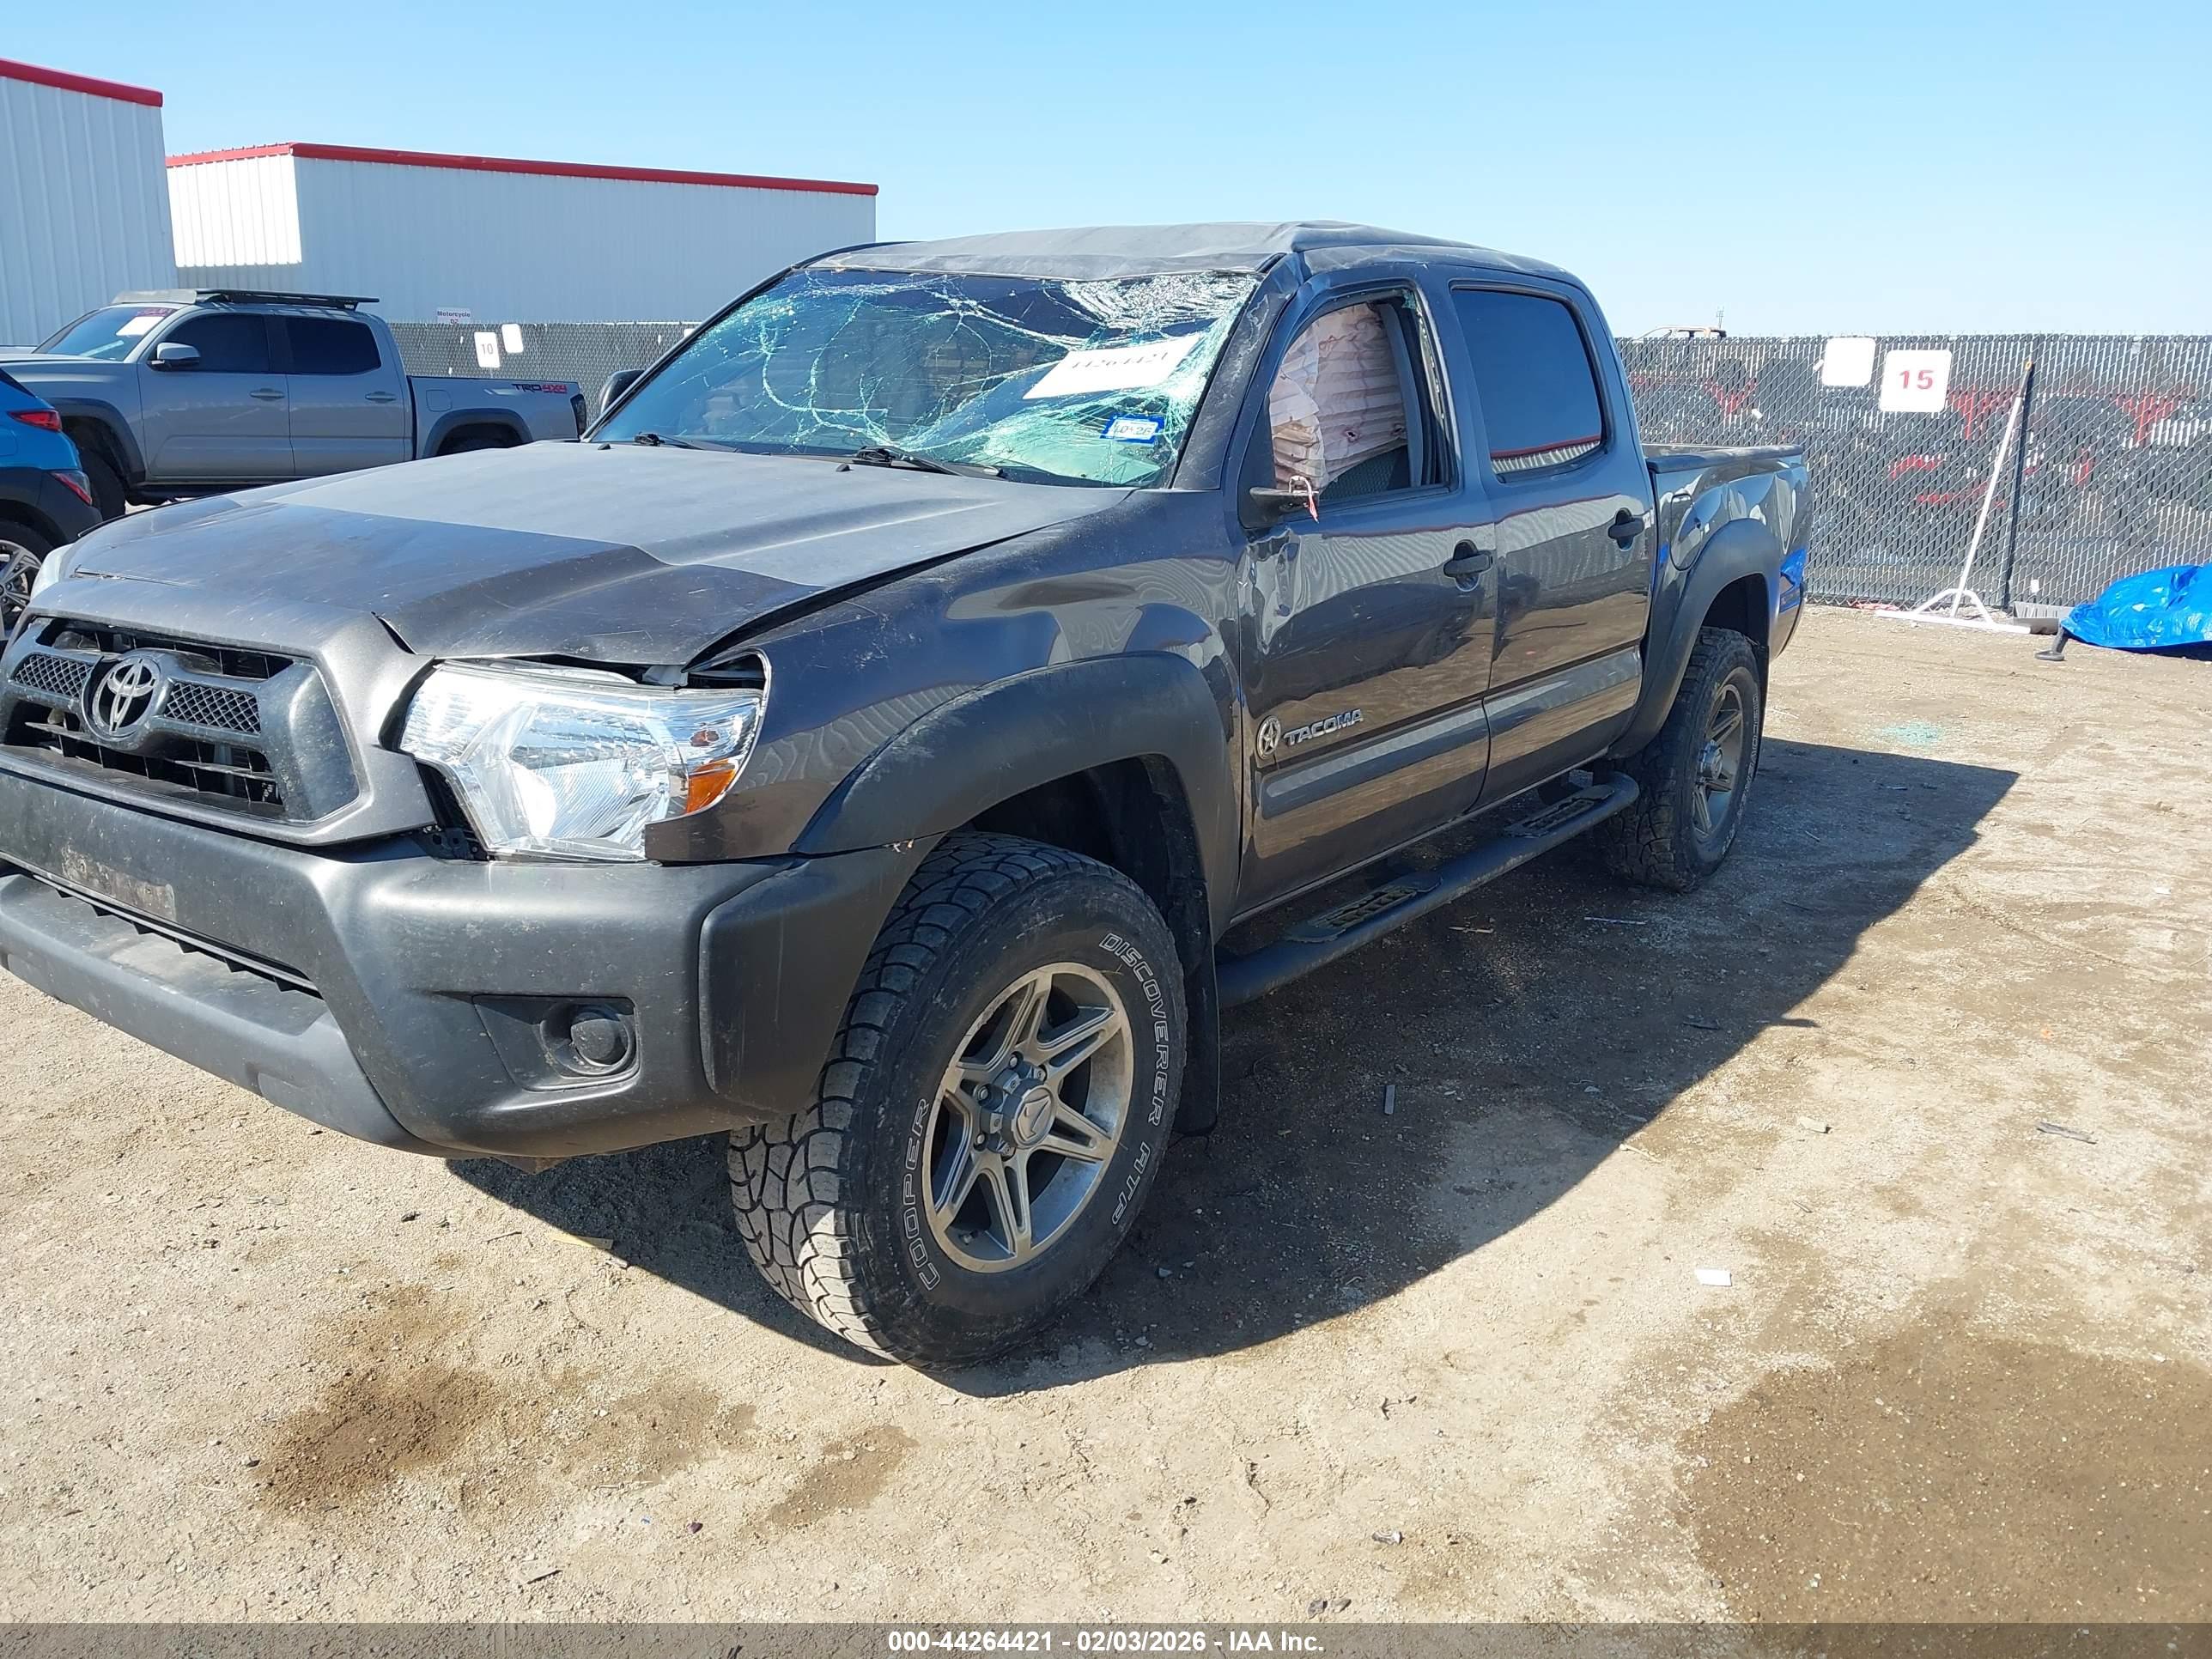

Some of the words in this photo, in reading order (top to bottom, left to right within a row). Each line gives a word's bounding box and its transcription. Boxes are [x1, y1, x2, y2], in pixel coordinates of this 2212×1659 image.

[481, 343, 494, 355] 10
[512, 383, 542, 392] TRD
[1899, 369, 1935, 390] 15
[1283, 708, 1364, 745] TACOMA
[1099, 933, 1170, 1127] DISCOVERER
[903, 1099, 941, 1291] COOPER
